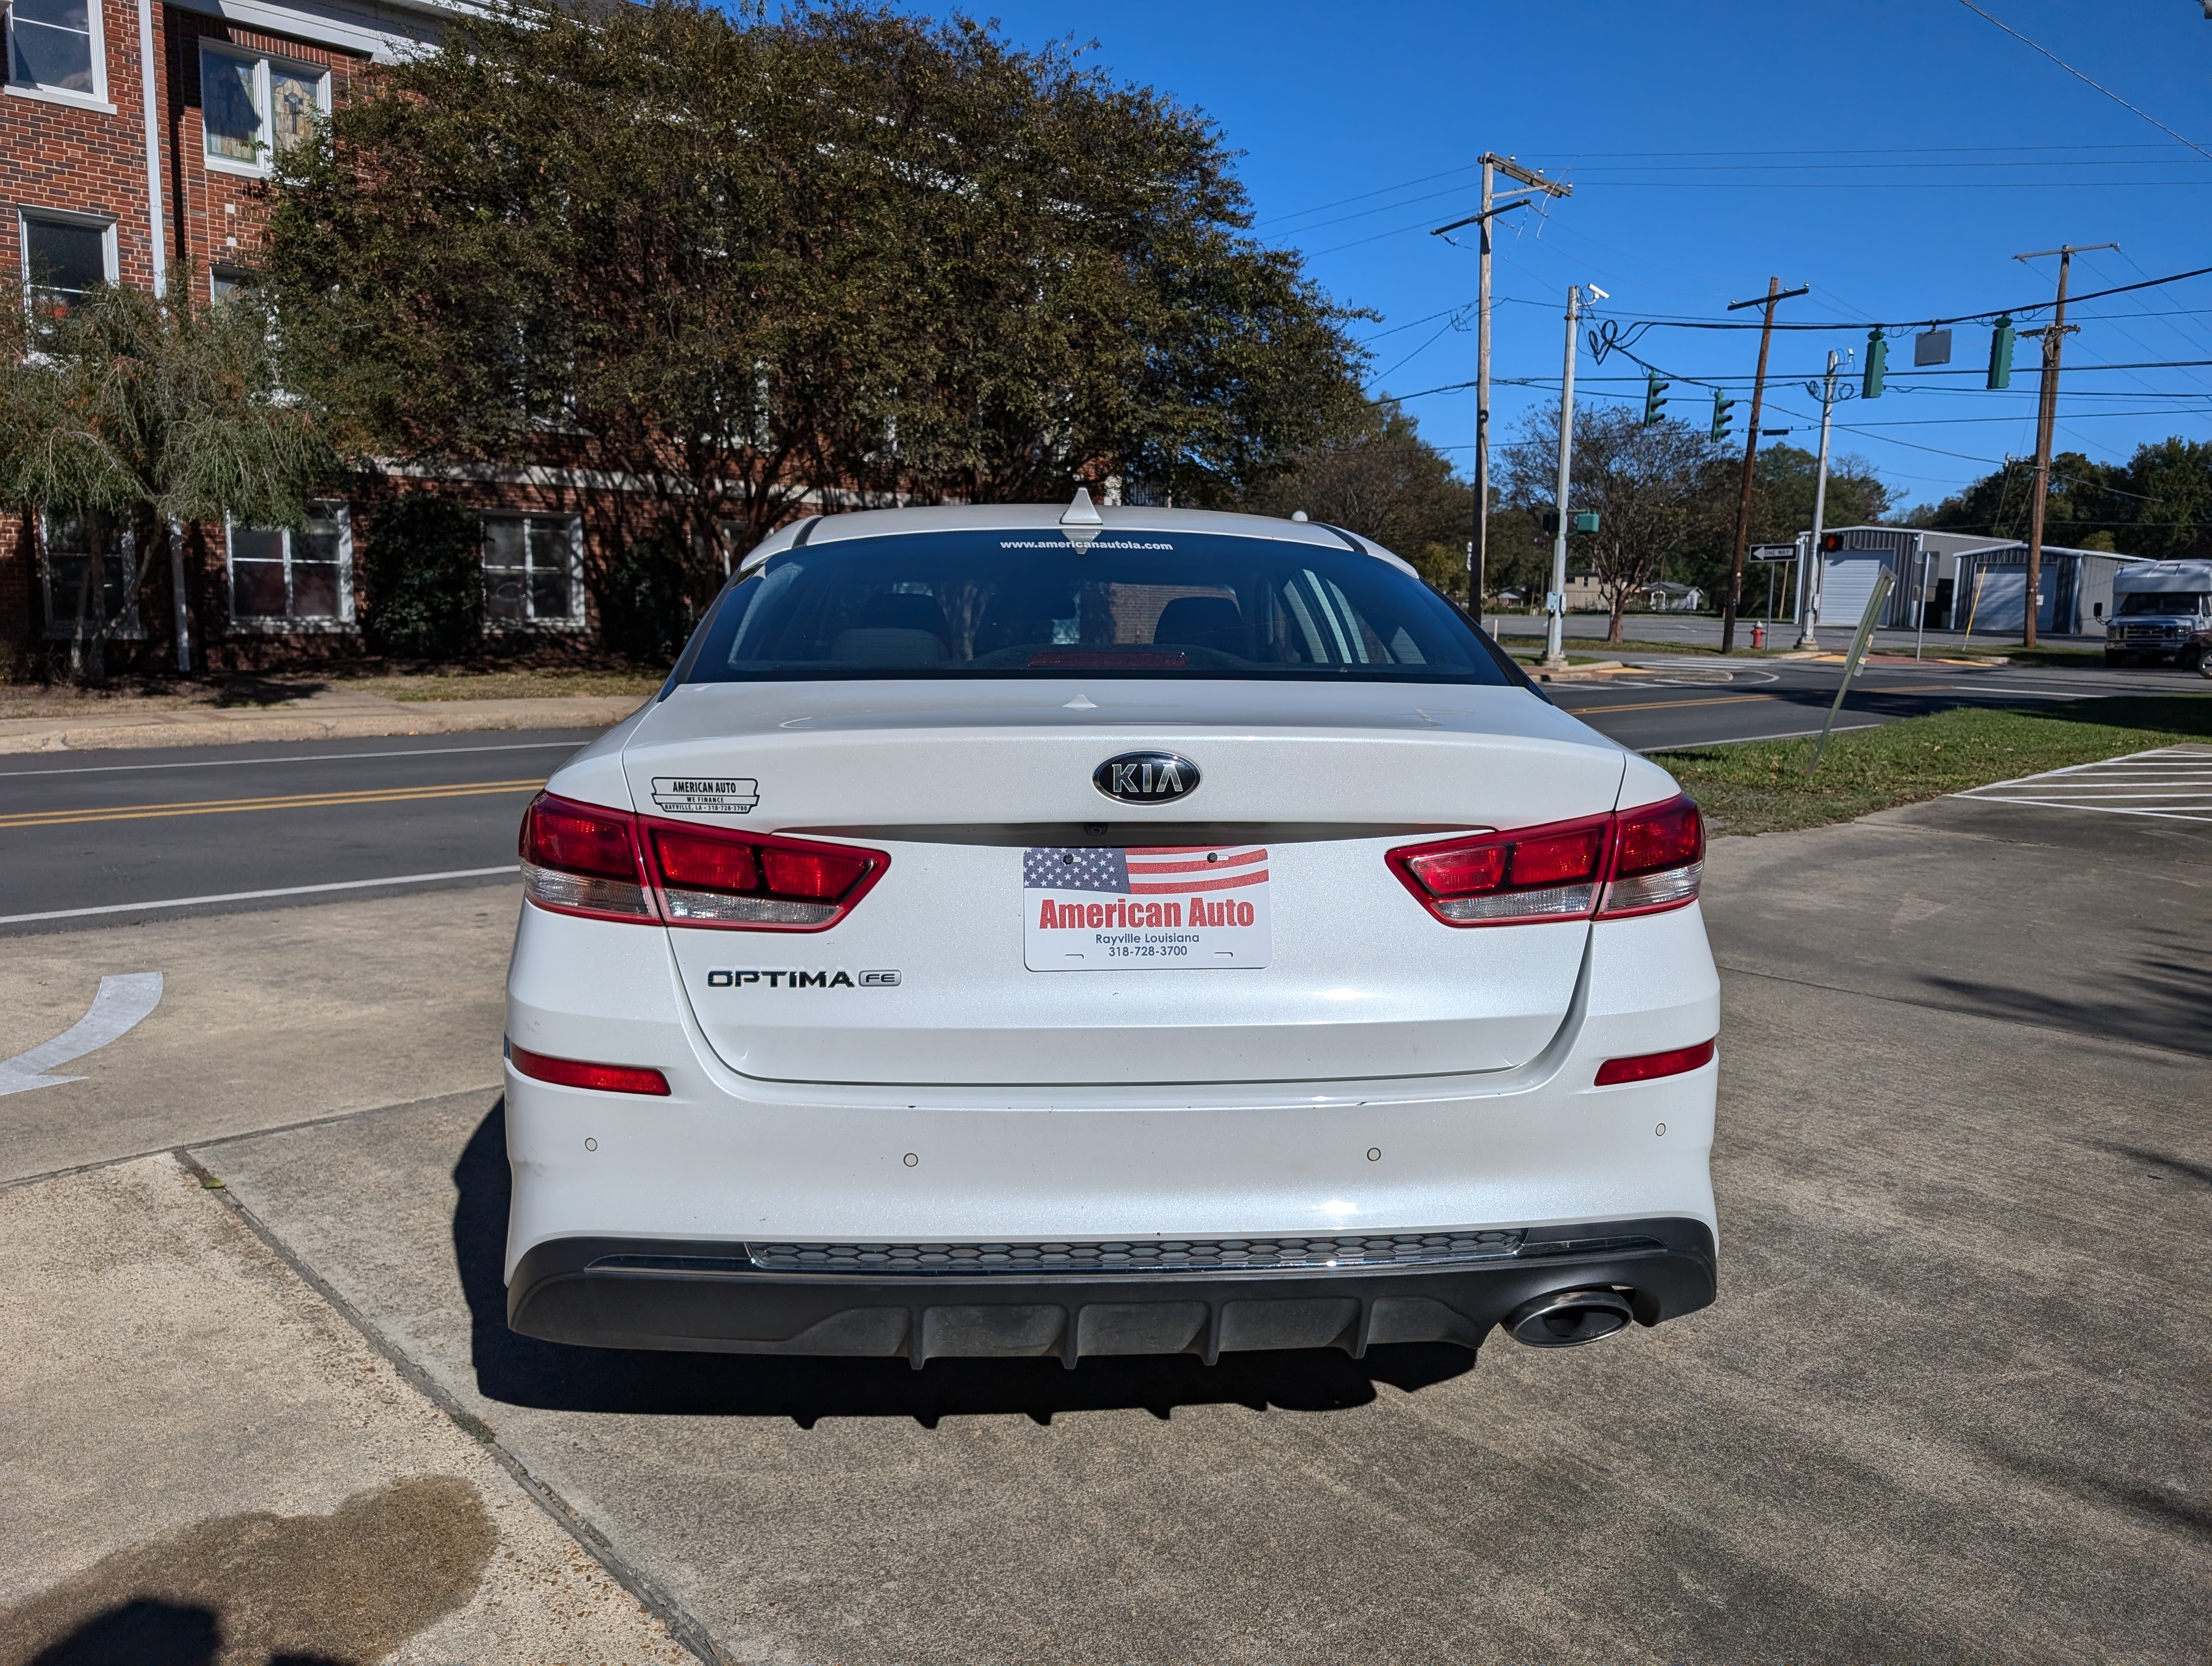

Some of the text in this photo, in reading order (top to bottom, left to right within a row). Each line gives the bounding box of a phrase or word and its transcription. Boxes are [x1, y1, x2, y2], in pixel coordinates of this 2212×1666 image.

[1000, 540, 1174, 550] www.americanautola.com
[1112, 764, 1183, 792] KIA
[673, 781, 736, 793] AMERICAN AUTO
[1039, 897, 1255, 929] American Auto
[1096, 933, 1200, 945] Rayville Louisiana
[1108, 946, 1188, 957] 318-728-3700
[708, 971, 895, 988] OPTIMA FE
